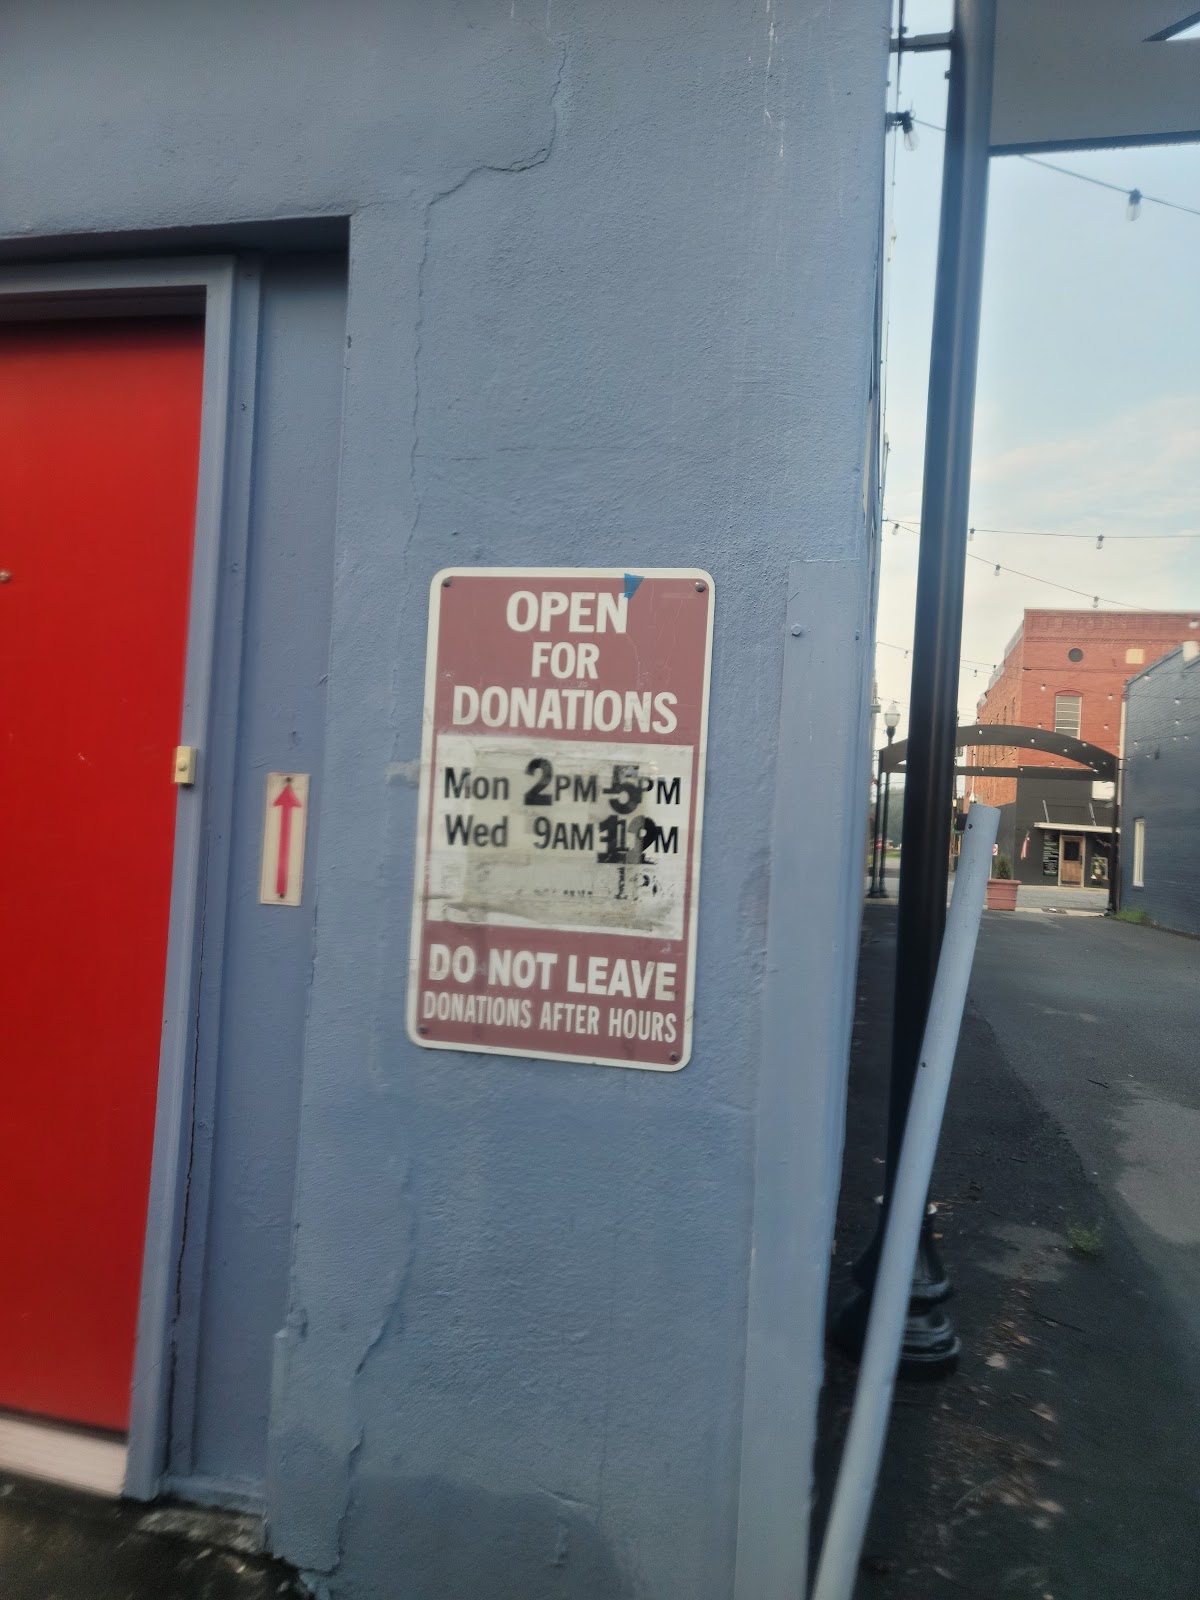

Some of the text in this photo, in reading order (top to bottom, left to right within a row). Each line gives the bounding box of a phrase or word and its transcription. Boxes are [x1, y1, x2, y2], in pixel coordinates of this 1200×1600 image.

[506, 590, 629, 634] OPEN
[531, 641, 600, 679] FOR
[452, 685, 678, 734] DONATIONS
[444, 767, 509, 801] Mon
[445, 814, 508, 848] Wed
[428, 943, 677, 1001] DO NOT LEAVE
[423, 991, 677, 1043] DONATIONS AFTER HOURS
